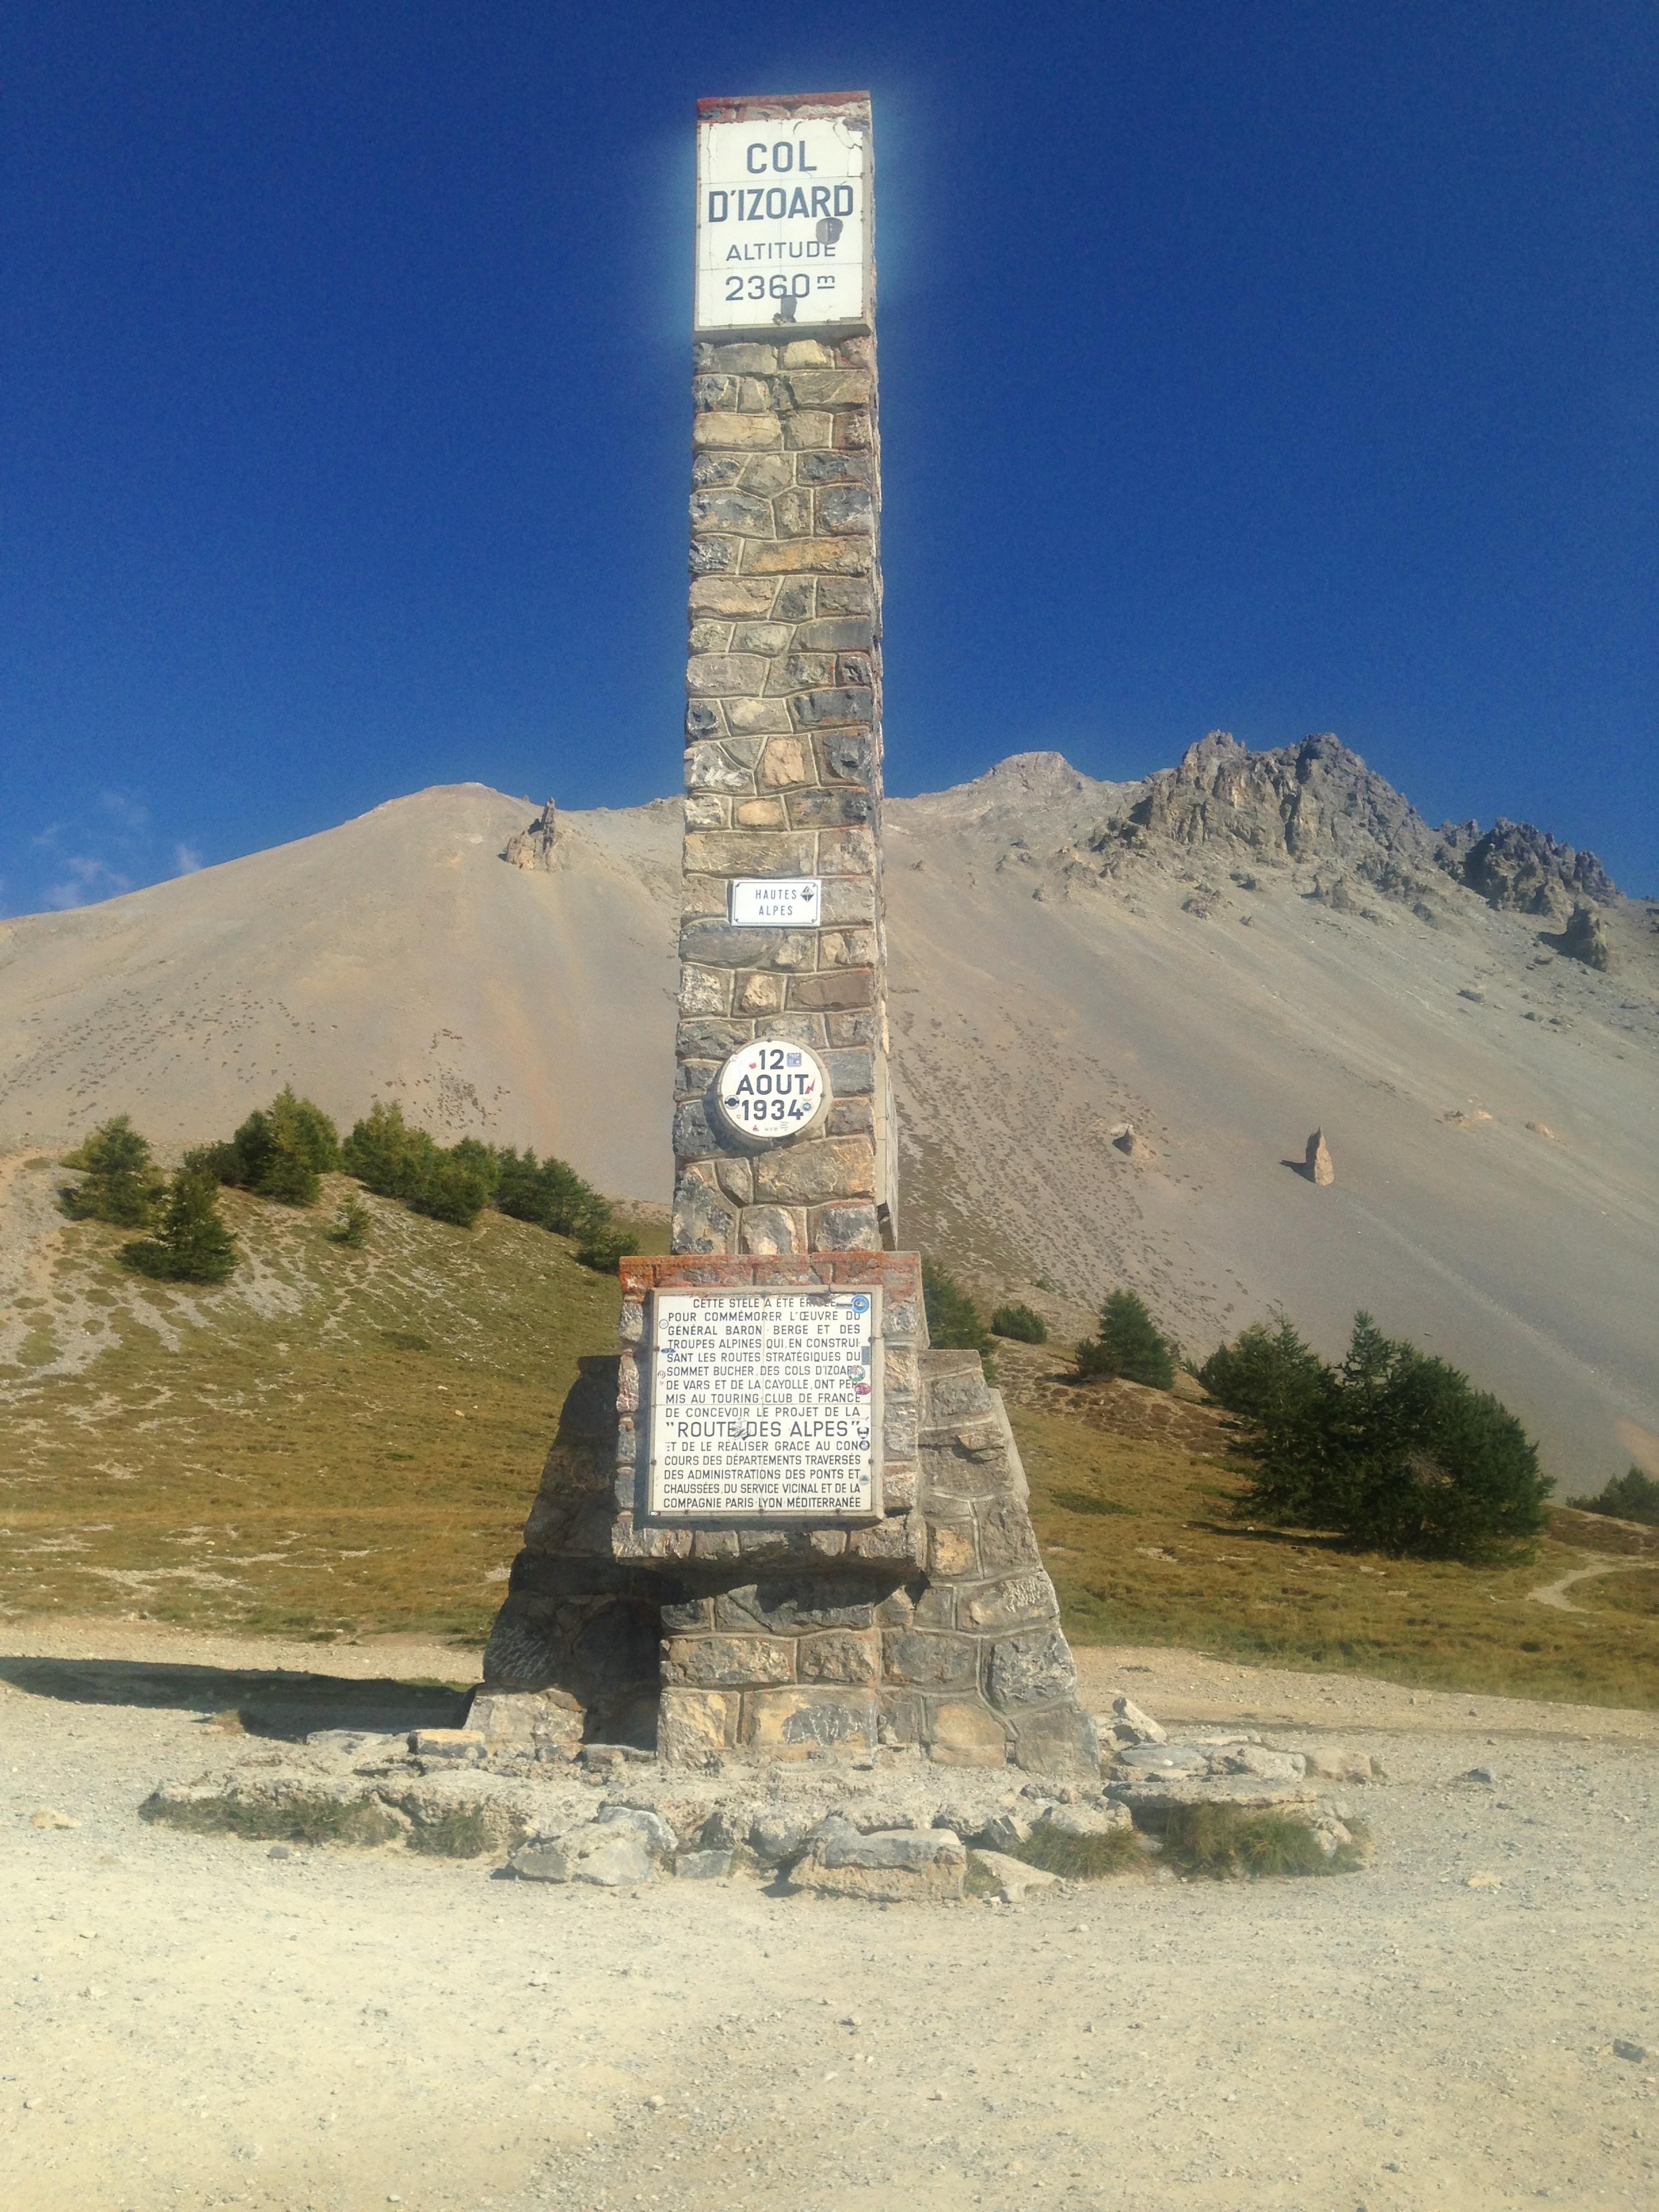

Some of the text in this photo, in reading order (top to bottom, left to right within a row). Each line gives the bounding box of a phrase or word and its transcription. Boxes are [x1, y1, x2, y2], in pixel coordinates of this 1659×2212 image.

[747, 141, 817, 173] COL
[709, 185, 854, 222] D'IZOARD
[726, 241, 836, 261] ALTITUDE
[725, 274, 810, 301] 2360
[756, 889, 796, 899] HAUTES
[759, 905, 792, 916] ALPES
[759, 1049, 783, 1069] 12
[736, 1074, 808, 1094] AOUT
[741, 1099, 804, 1120] 1934
[693, 1298, 724, 1308] CETTE
[764, 1298, 771, 1307] A
[668, 1312, 696, 1322] POUR
[846, 1311, 861, 1320] DU
[726, 1326, 762, 1334] BARON
[774, 1325, 808, 1334] BERGE
[818, 1325, 830, 1334] ET
[840, 1324, 860, 1334] DES
[668, 1339, 714, 1349] TROUPES
[719, 1339, 761, 1348] ALPINES
[790, 1338, 801, 1348] EN
[667, 1353, 693, 1362] SANT
[699, 1353, 716, 1362] LES
[722, 1353, 760, 1361] ROUTES
[846, 1352, 861, 1361] DU
[667, 1366, 709, 1376] SOMMET
[760, 1366, 779, 1375] DES
[785, 1366, 810, 1375] COLS
[667, 1380, 678, 1390] DE
[683, 1380, 710, 1389] VARS
[716, 1380, 726, 1389] ET
[731, 1380, 743, 1389] DE
[749, 1380, 760, 1389] LA
[815, 1379, 834, 1389] ONT
[666, 1394, 685, 1404] MIS
[691, 1394, 705, 1404] AU
[799, 1393, 813, 1403] DE
[819, 1393, 861, 1403] FRANCE
[666, 1407, 860, 1417] DE CONCEVOIR LE PROJET DE LA
[746, 1421, 781, 1437] DES
[682, 1442, 695, 1451] DE
[701, 1442, 712, 1451] LE
[775, 1441, 809, 1451] GRACE
[816, 1441, 830, 1450] AU
[665, 1456, 699, 1465] COURS
[703, 1456, 722, 1465] DES
[665, 1469, 860, 1479] DES ADMINISTRATIONS DES PONTS ET
[724, 1483, 737, 1493] DU
[741, 1483, 779, 1493] SERVICE
[782, 1483, 818, 1493] VICINAL
[822, 1483, 832, 1493] ET
[836, 1483, 846, 1493] DE
[851, 1483, 860, 1492] LA
[664, 1498, 721, 1508] COMPAGNIE
